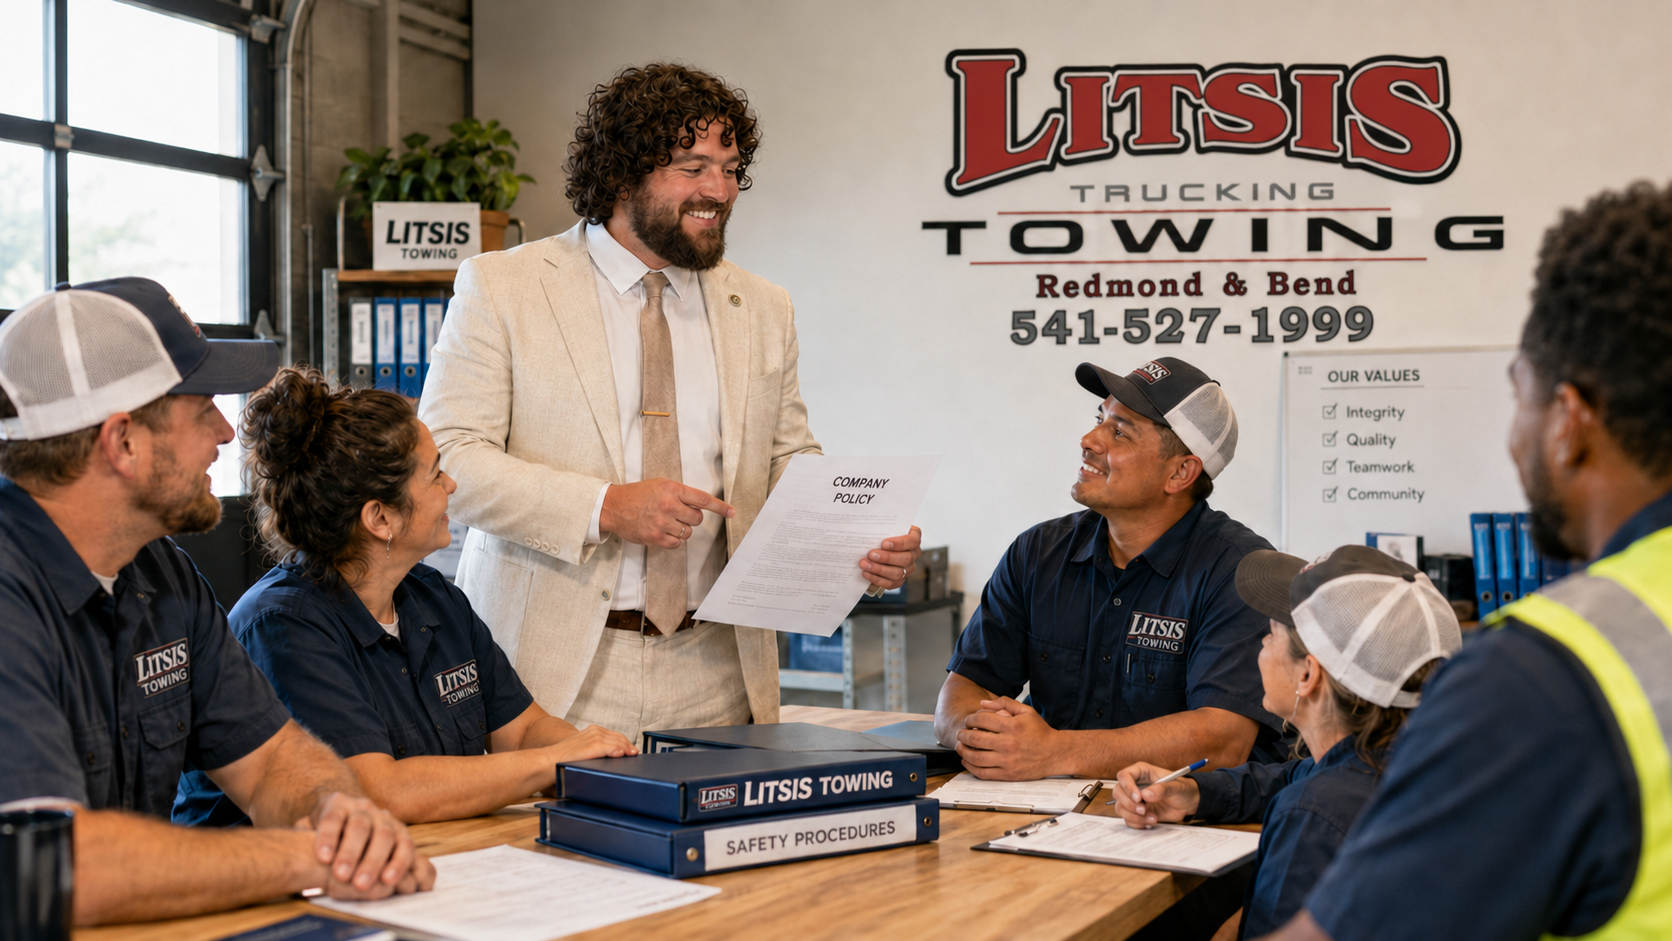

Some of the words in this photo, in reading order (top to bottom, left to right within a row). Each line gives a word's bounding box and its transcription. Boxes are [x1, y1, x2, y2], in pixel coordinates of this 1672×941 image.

[945, 49, 1461, 196] LITSIS
[1069, 182, 1335, 203] TRUCKING
[386, 220, 470, 245] LITSIS
[921, 216, 1505, 255] TOWING
[401, 248, 458, 259] TOWING
[1036, 272, 1204, 298] Redmond
[1222, 272, 1248, 296] &
[1267, 270, 1357, 296] Bend
[1010, 306, 1374, 345] 541-527-1999
[1328, 370, 1359, 383] OUR
[1365, 369, 1421, 382] VALUES
[1346, 405, 1406, 422] Integrity
[1346, 433, 1397, 449] Quality
[1346, 460, 1416, 474] Teamwork
[832, 475, 890, 489] COMPANY
[832, 493, 876, 505] POLICY
[1347, 487, 1426, 503] Community
[1128, 614, 1186, 640] LITSIS
[1137, 636, 1179, 652] TOWING
[135, 643, 187, 682] LITSIS
[141, 668, 188, 695] TOWING
[436, 663, 478, 697] LITSIS
[446, 682, 480, 705] TOWING
[701, 787, 736, 804] LITSIS
[743, 776, 813, 807] LITSIS
[819, 770, 894, 796] TOWING
[726, 833, 789, 856] SAFETY
[794, 820, 897, 847] PROCEDURES
